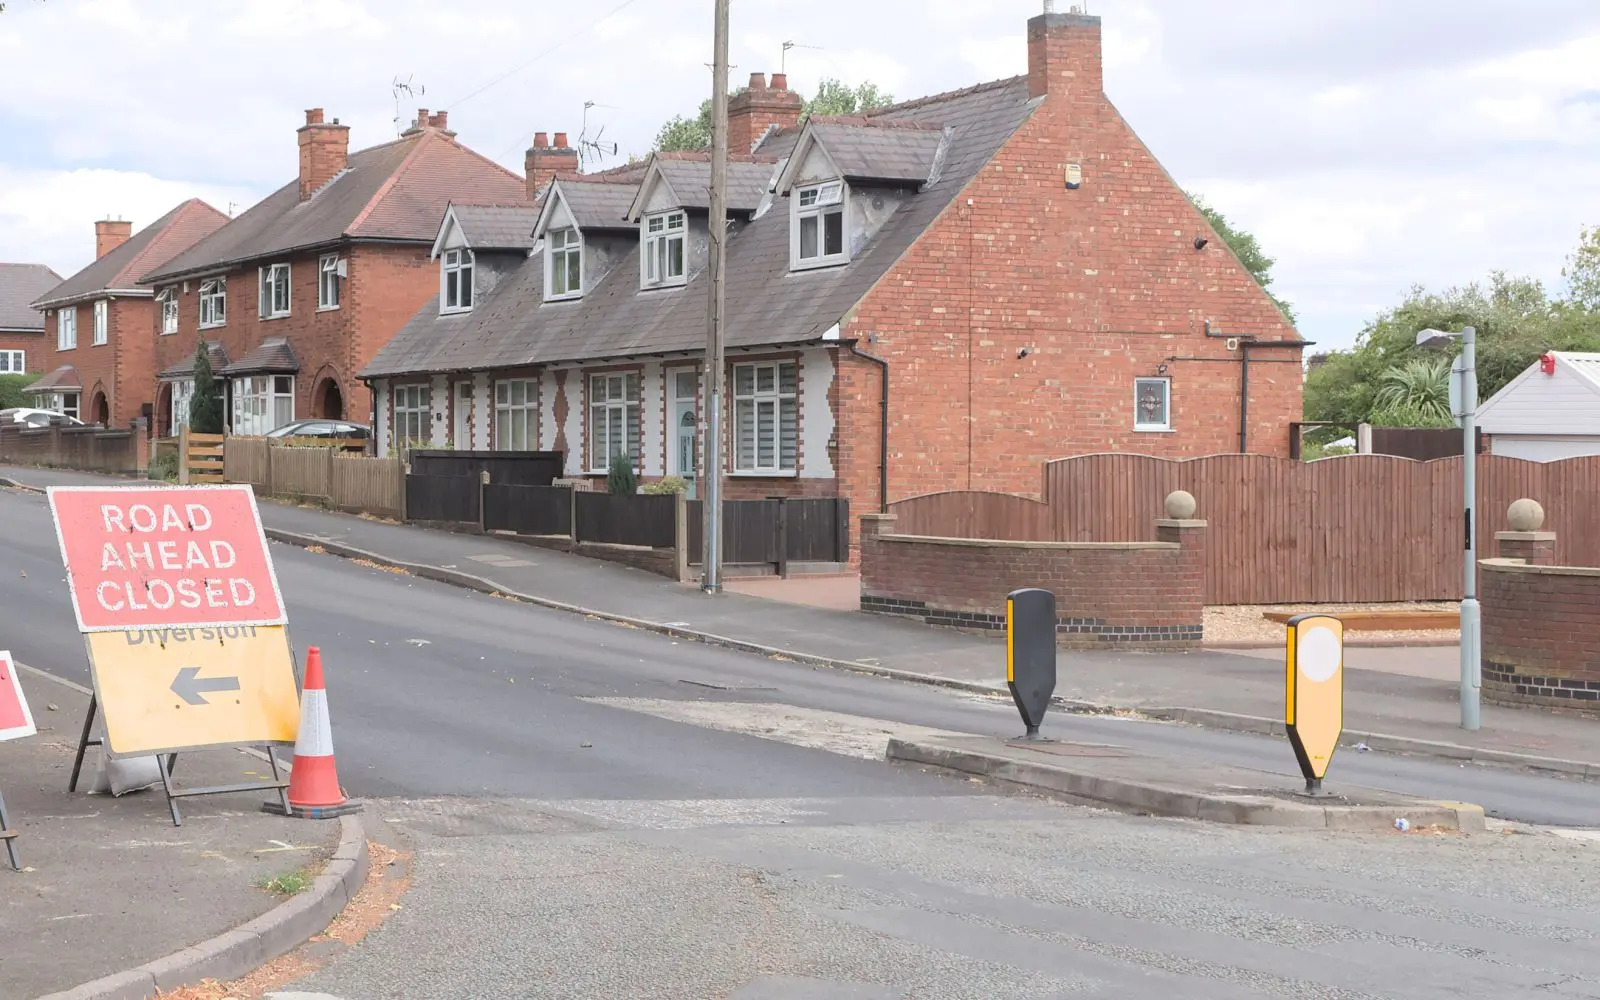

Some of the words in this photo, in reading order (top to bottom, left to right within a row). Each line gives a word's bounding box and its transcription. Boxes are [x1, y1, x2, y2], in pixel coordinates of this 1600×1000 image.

[101, 504, 212, 533] ROAD
[101, 540, 236, 571] AHEAD
[96, 578, 256, 611] CLOSED
